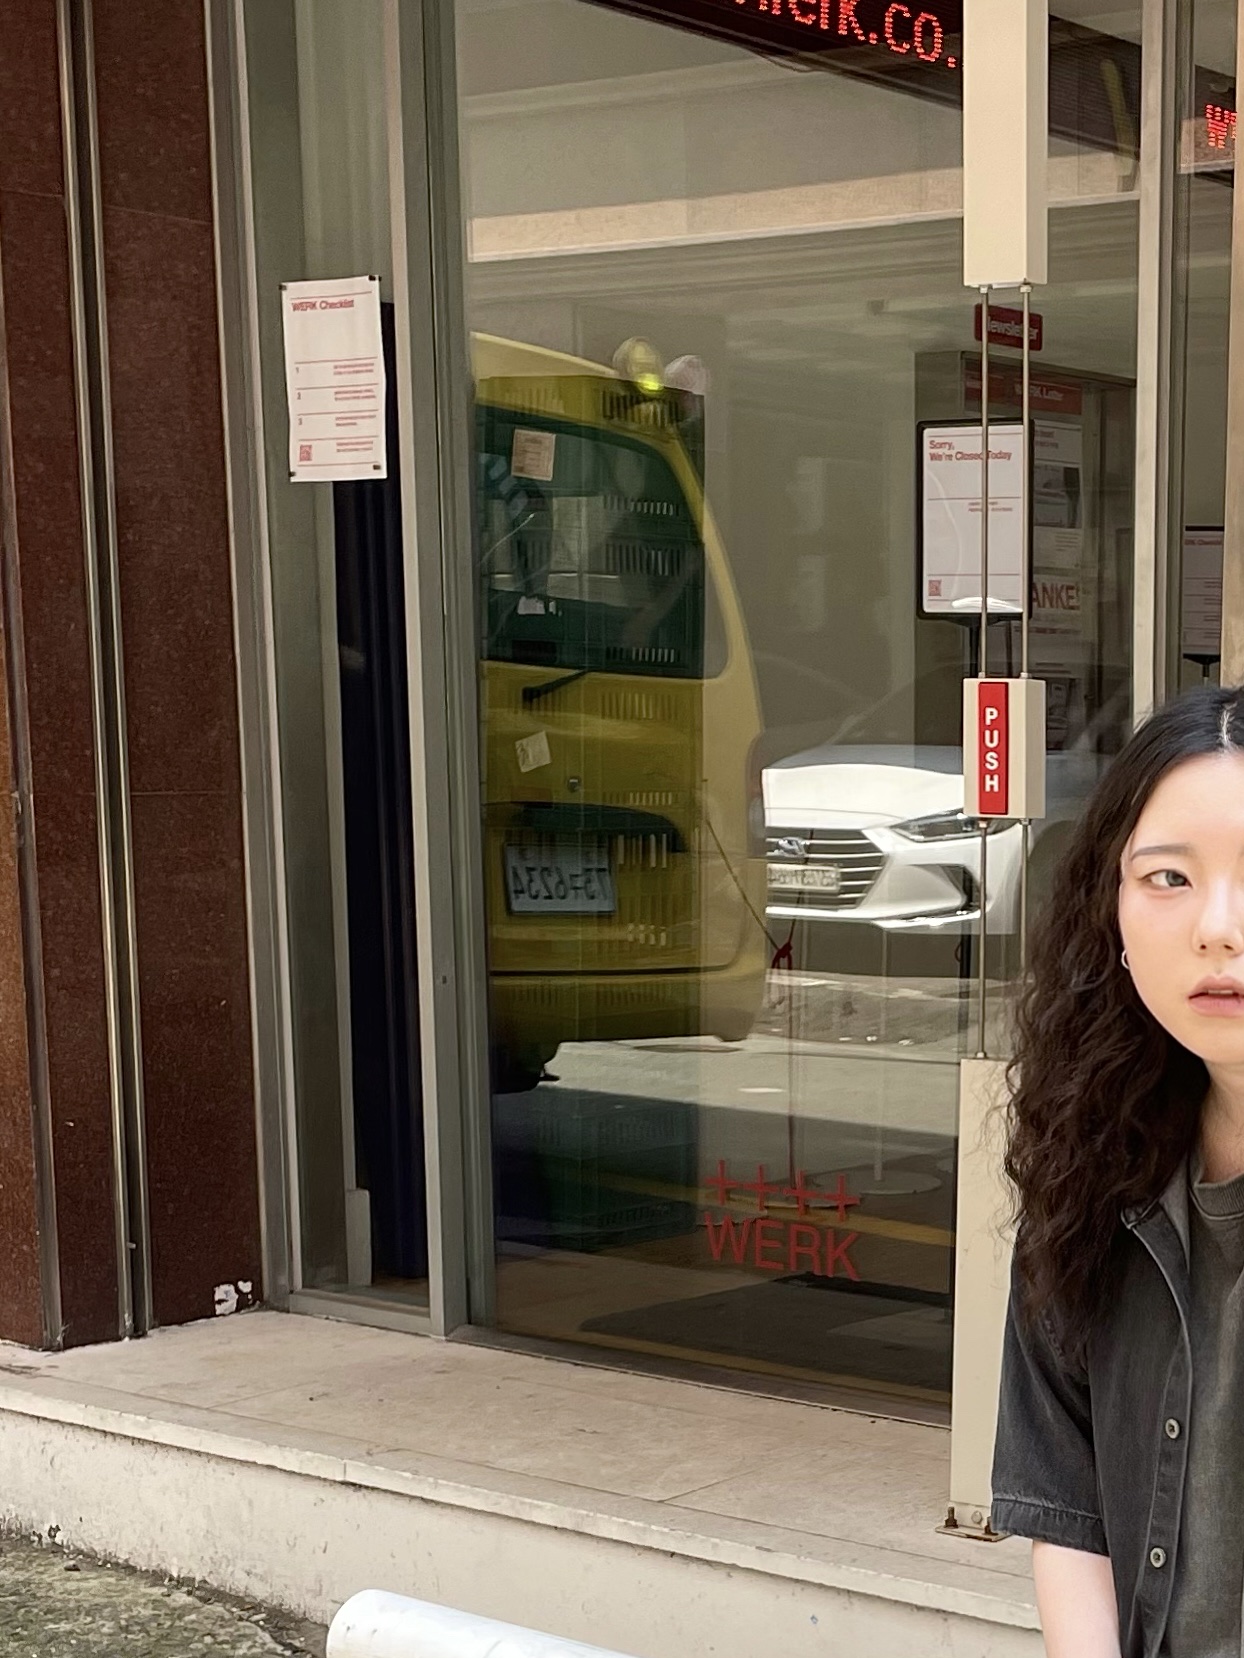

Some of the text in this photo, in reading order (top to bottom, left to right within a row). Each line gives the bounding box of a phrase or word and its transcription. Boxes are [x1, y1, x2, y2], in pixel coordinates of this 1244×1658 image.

[292, 299, 355, 312] WERK Checklist
[929, 440, 955, 451] Sorry,
[984, 707, 999, 793] PUSH
[703, 1211, 862, 1282] WERK
